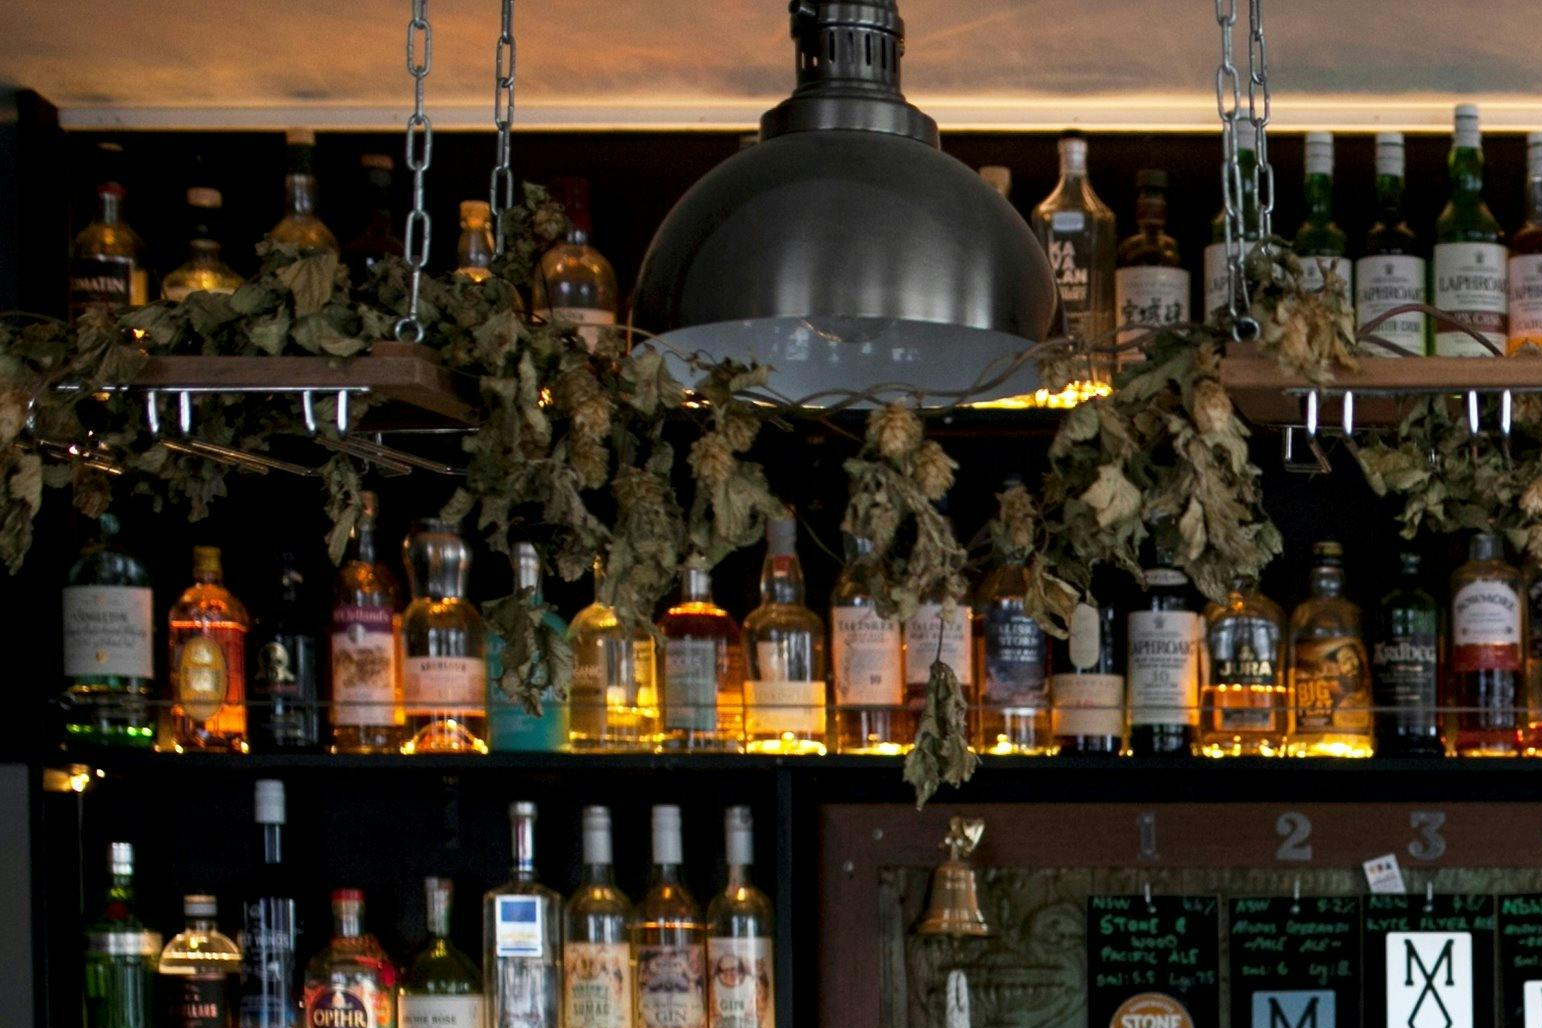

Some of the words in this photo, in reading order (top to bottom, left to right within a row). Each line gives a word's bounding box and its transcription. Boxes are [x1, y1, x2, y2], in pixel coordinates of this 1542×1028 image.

[1218, 660, 1273, 677] JURA
[1137, 811, 1158, 861] 1
[1275, 811, 1313, 861] 2
[1408, 811, 1446, 861] 3
[1100, 915, 1159, 934] STONE
[1168, 948, 1200, 964] ALE
[313, 1007, 367, 1028] OPIHR
